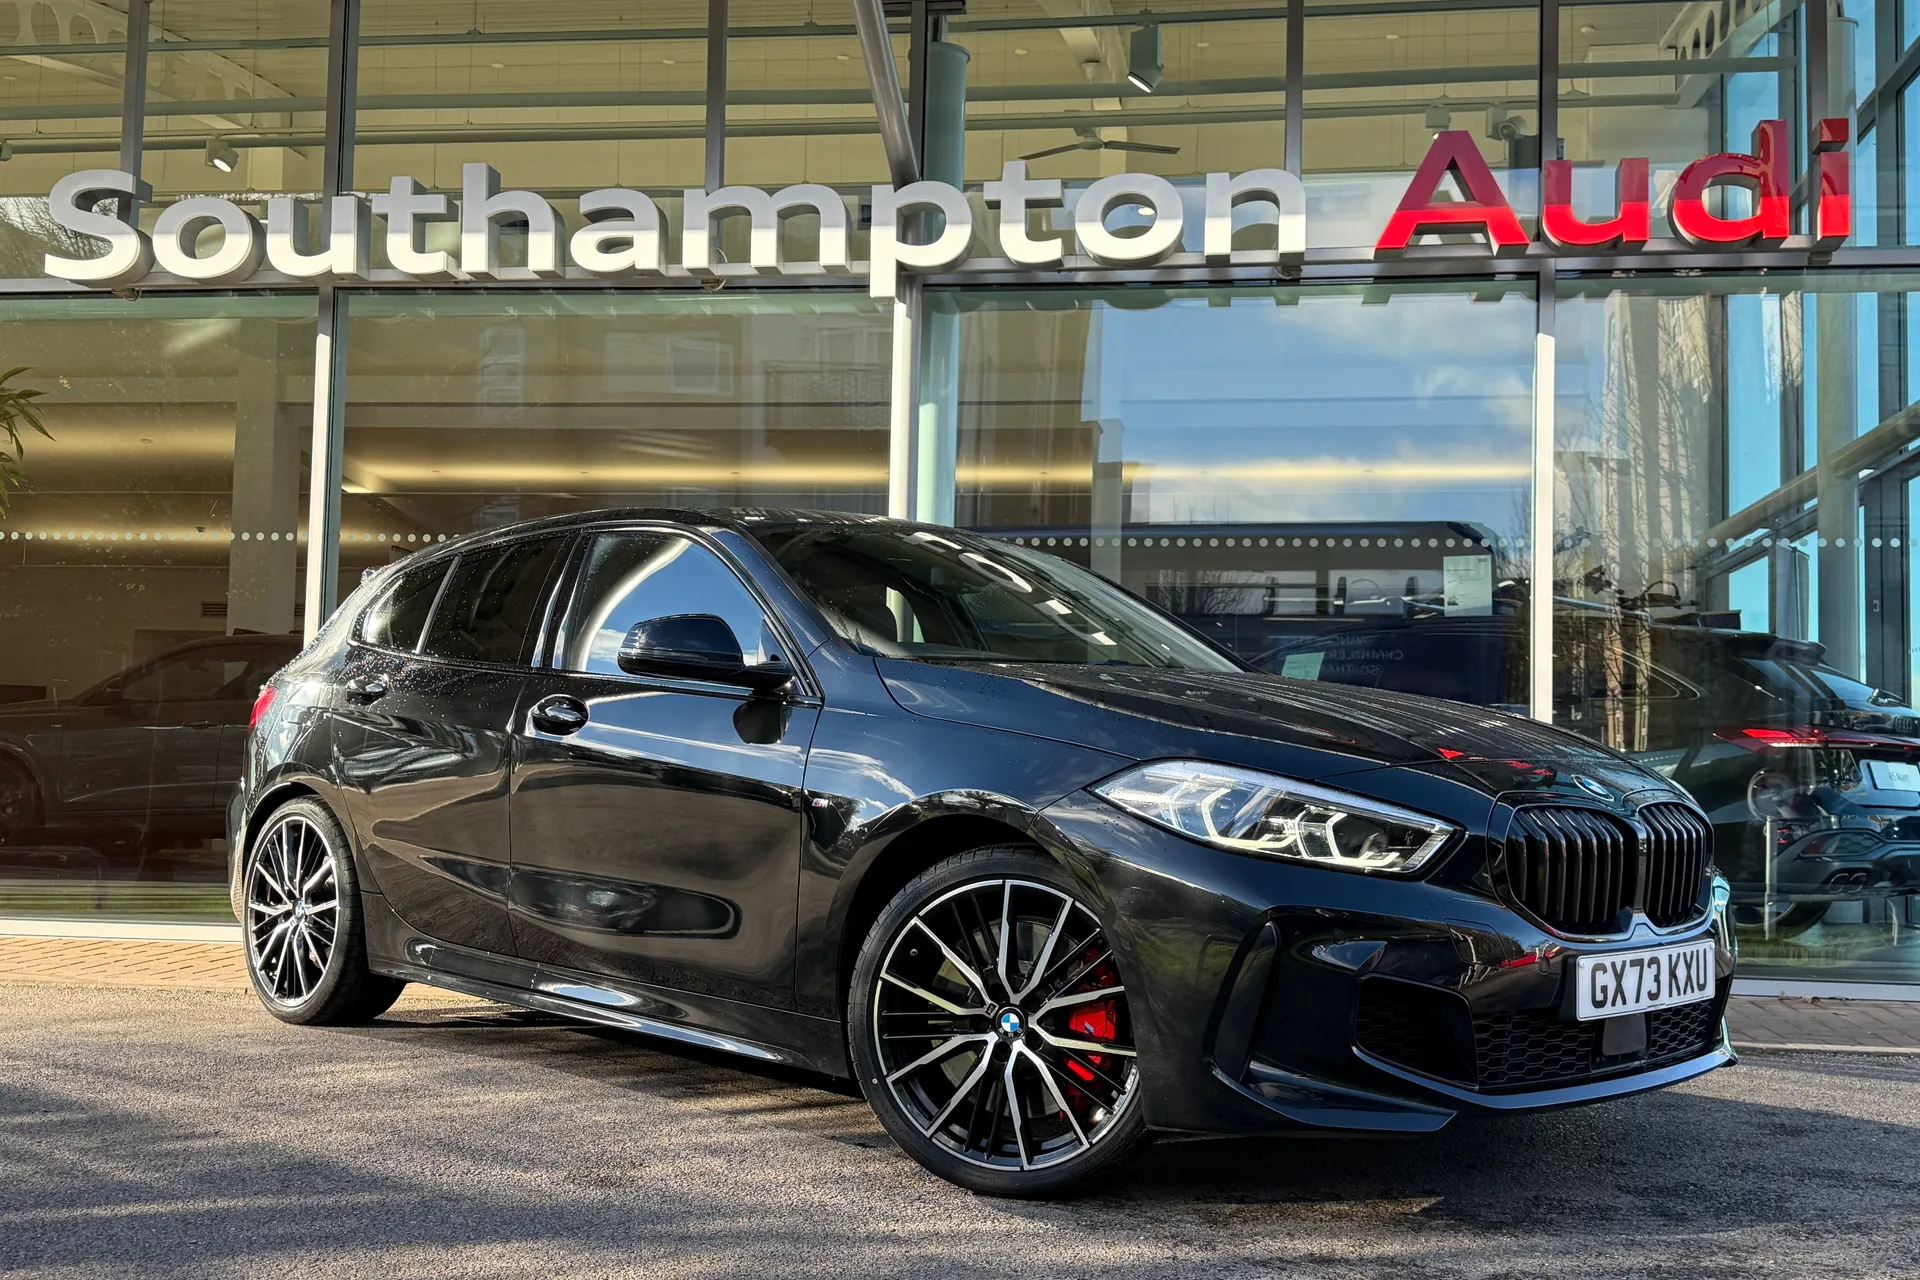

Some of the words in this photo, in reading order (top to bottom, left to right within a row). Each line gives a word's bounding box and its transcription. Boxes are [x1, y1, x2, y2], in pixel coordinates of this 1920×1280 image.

[45, 163, 1307, 298] Southampton
[1375, 119, 1851, 258] Audi
[1590, 956, 1661, 1009] GX73
[1668, 948, 1707, 998] KXU
